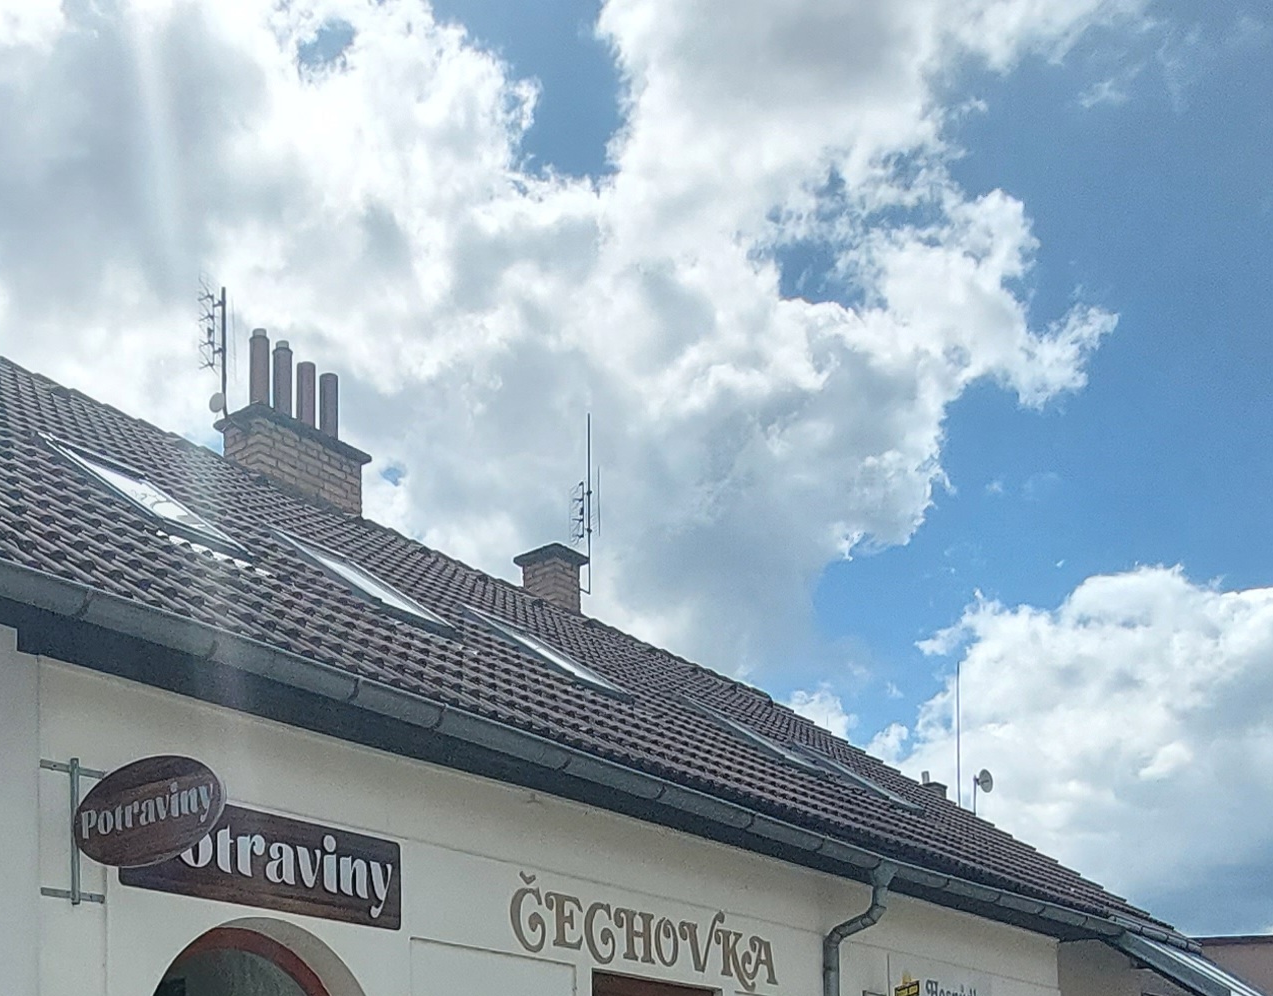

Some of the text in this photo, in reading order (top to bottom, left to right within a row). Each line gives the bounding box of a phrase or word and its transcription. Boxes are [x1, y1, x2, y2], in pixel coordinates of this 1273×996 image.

[81, 782, 214, 840] Potraviny
[179, 824, 394, 919] otraviny
[509, 870, 779, 991] ČECHOVKA
